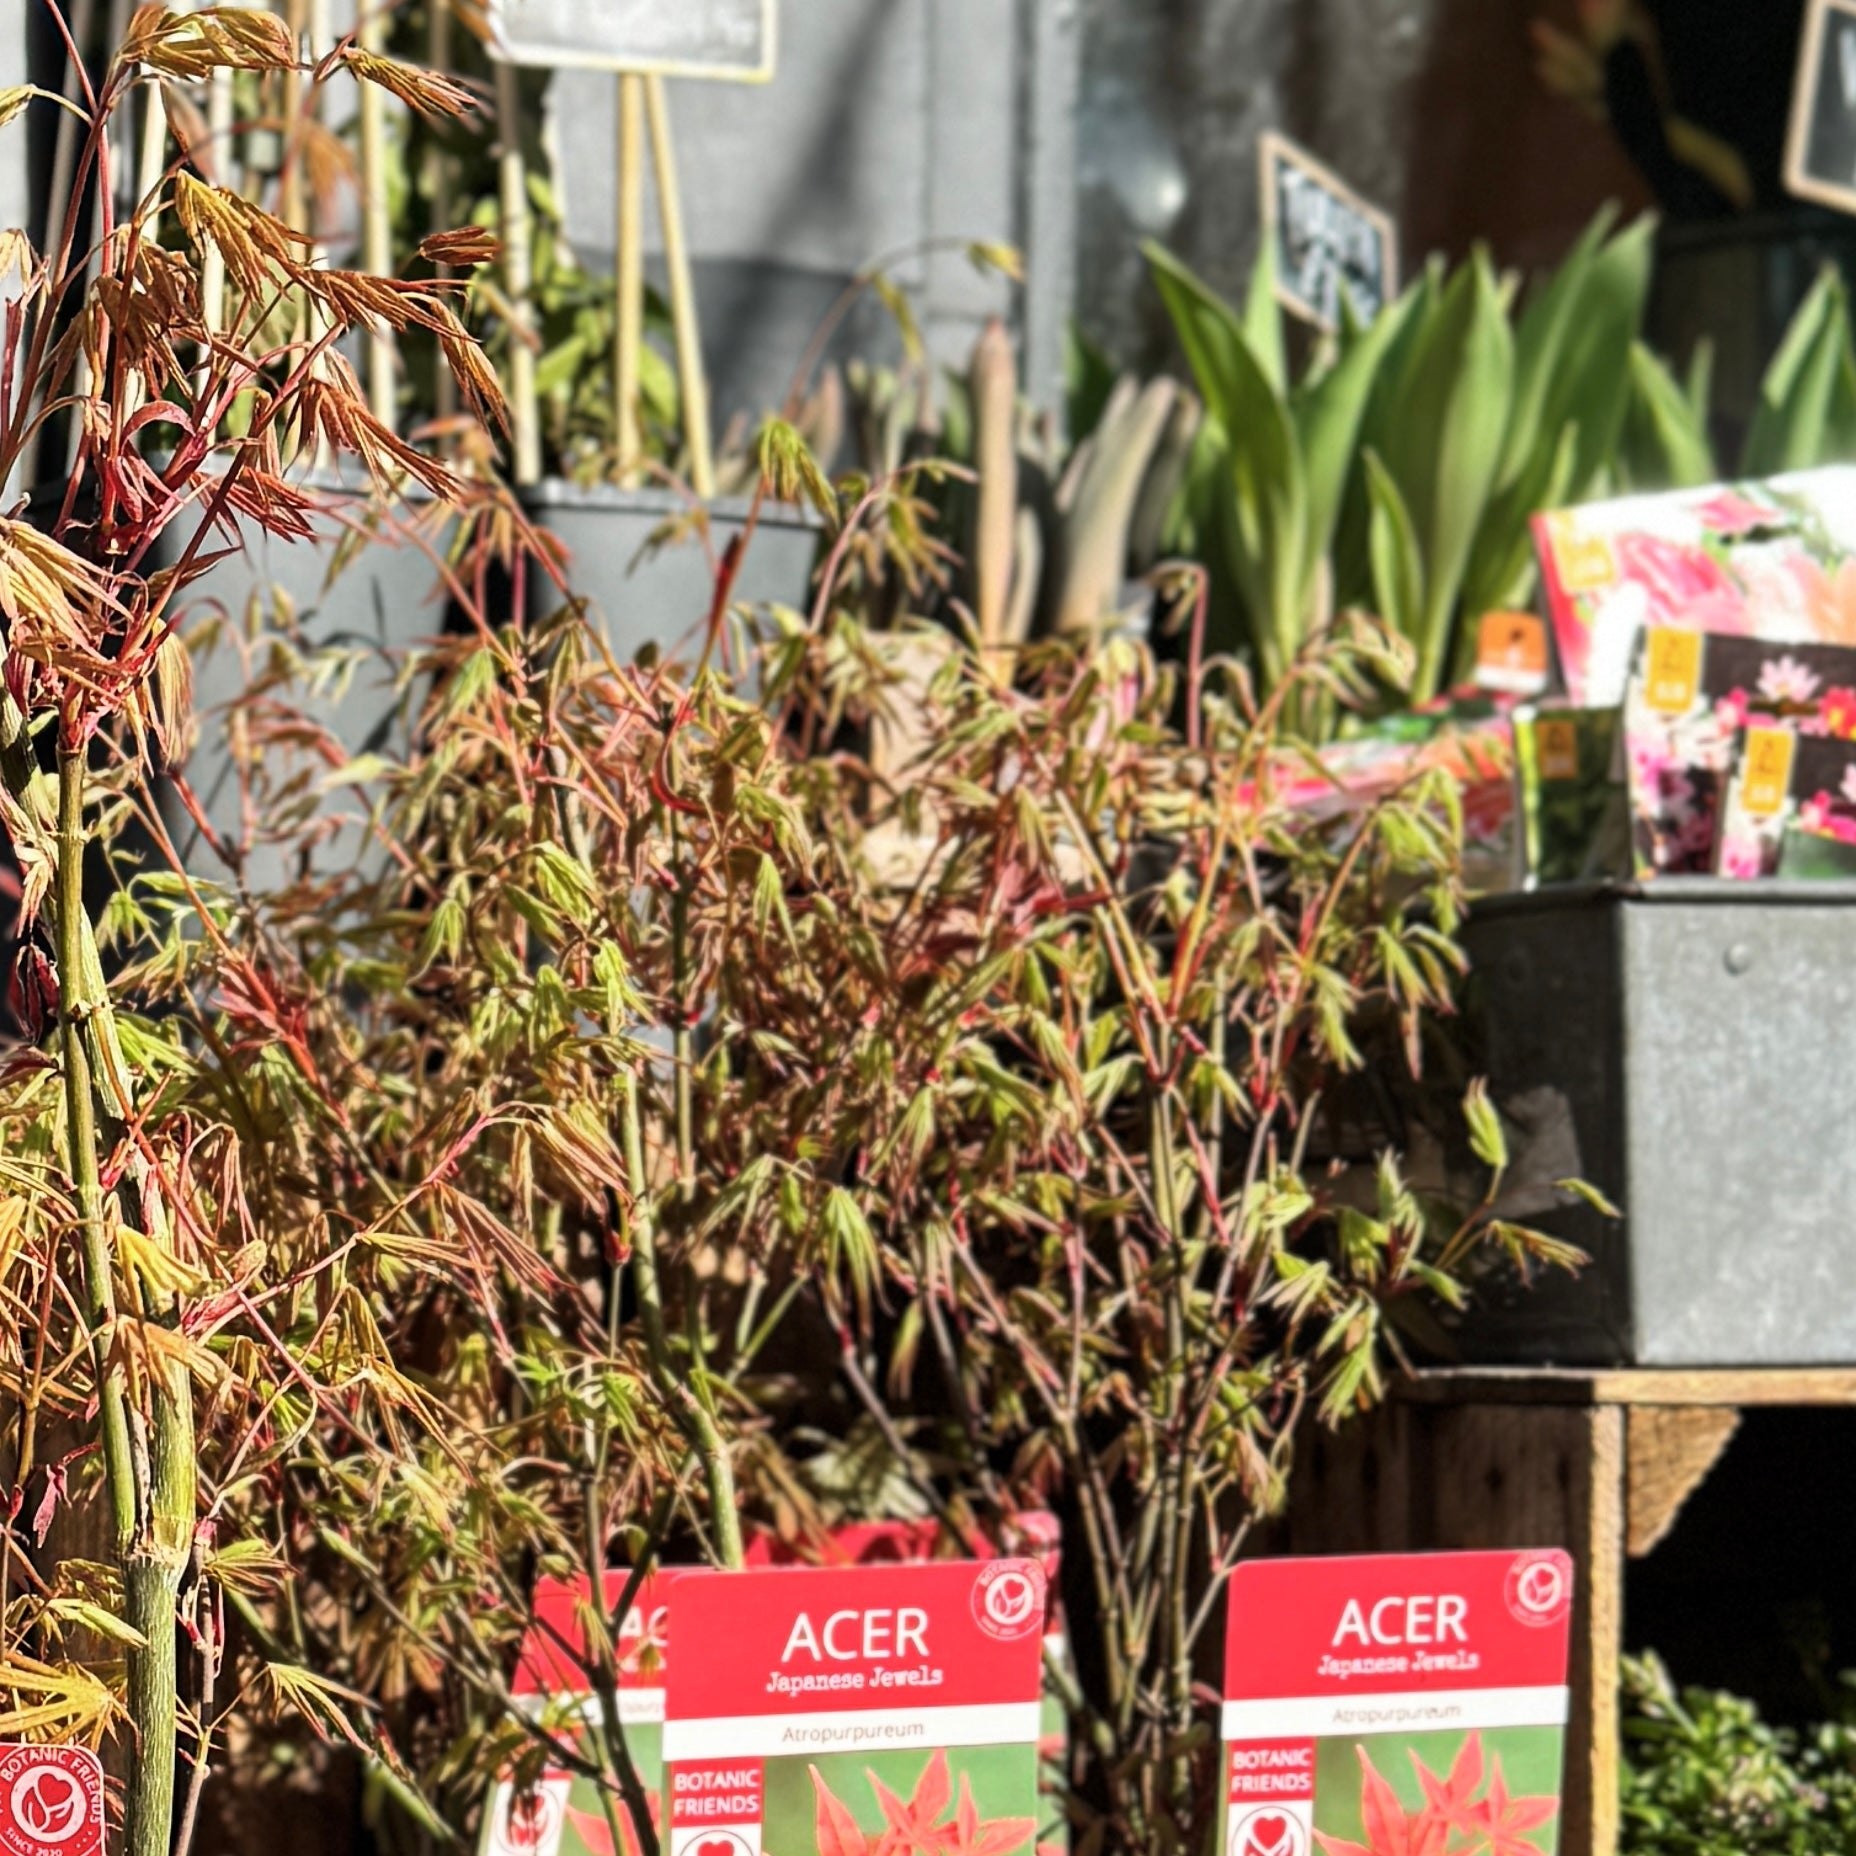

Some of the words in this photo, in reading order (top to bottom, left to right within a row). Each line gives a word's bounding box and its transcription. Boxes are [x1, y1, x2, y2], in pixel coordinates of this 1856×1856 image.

[1332, 1595, 1468, 1646] ACER
[781, 1607, 930, 1663] ACER
[1318, 1655, 1407, 1680] Japanese
[1412, 1650, 1480, 1671] Jewels
[766, 1671, 864, 1697] Japanese
[869, 1665, 944, 1687] Jewels
[1332, 1705, 1462, 1723] Atropurpureum
[782, 1722, 924, 1744] Atropurpureum
[1233, 1748, 1312, 1770] BOTANIC
[0, 1747, 68, 1782] BOTANIC
[70, 1757, 102, 1823] FRIENDS
[674, 1769, 761, 1791] BOTANIC
[1231, 1773, 1311, 1792] FRIENDS
[673, 1795, 759, 1816] FRIENDS
